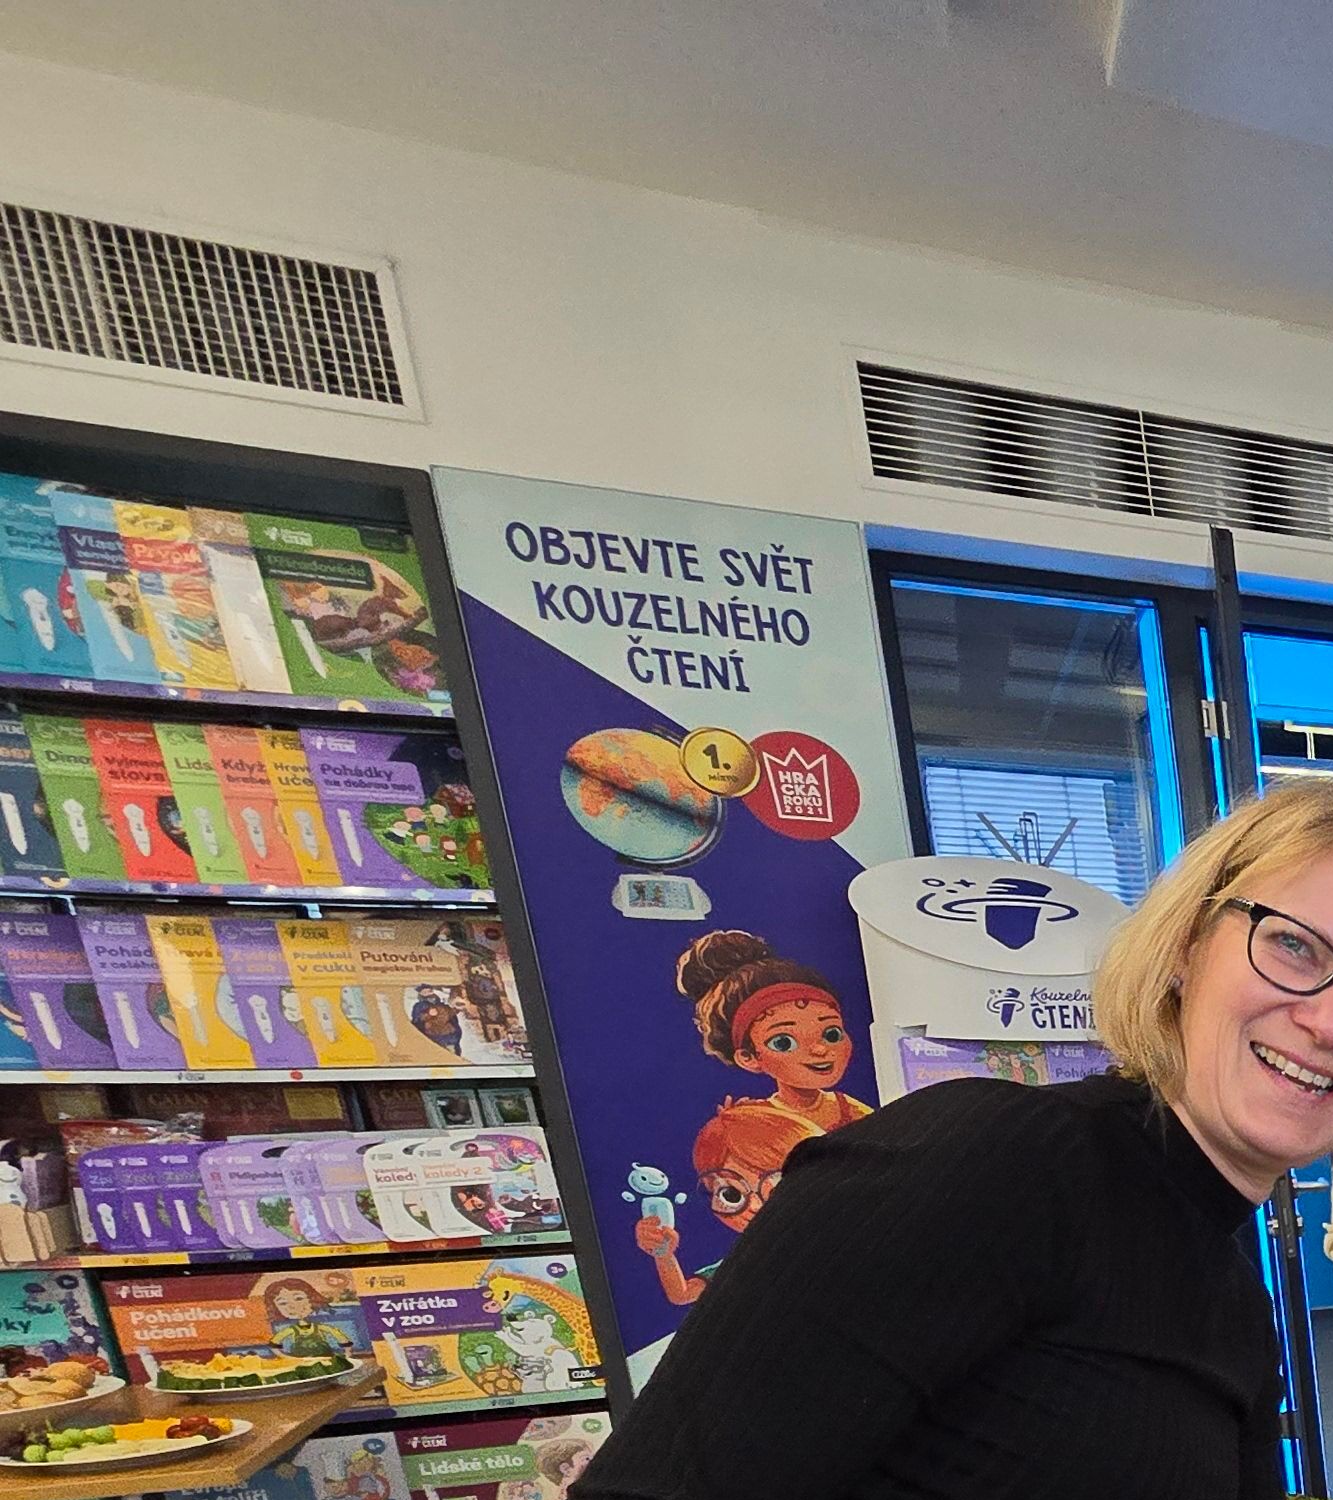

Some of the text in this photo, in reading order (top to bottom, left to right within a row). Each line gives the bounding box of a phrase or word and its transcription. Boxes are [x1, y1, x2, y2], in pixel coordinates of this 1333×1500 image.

[505, 521, 813, 595] OBJEVTE SVĚT
[531, 580, 810, 647] KOUZELNÉHO
[626, 634, 750, 693] ČTENÍ
[702, 743, 732, 771] 1.
[320, 763, 394, 782] Pohádky
[778, 770, 819, 786] HRA
[780, 783, 822, 798] CKA
[783, 795, 823, 808] ROKU
[360, 951, 434, 963] Putování
[473, 1167, 483, 1176] 2
[377, 1296, 459, 1314] Zvířátka
[130, 1306, 246, 1325] Pohádkové
[382, 1317, 396, 1328] v
[400, 1314, 435, 1327] zoo
[134, 1324, 199, 1342] učení
[419, 1455, 525, 1476] Lidské tělo
